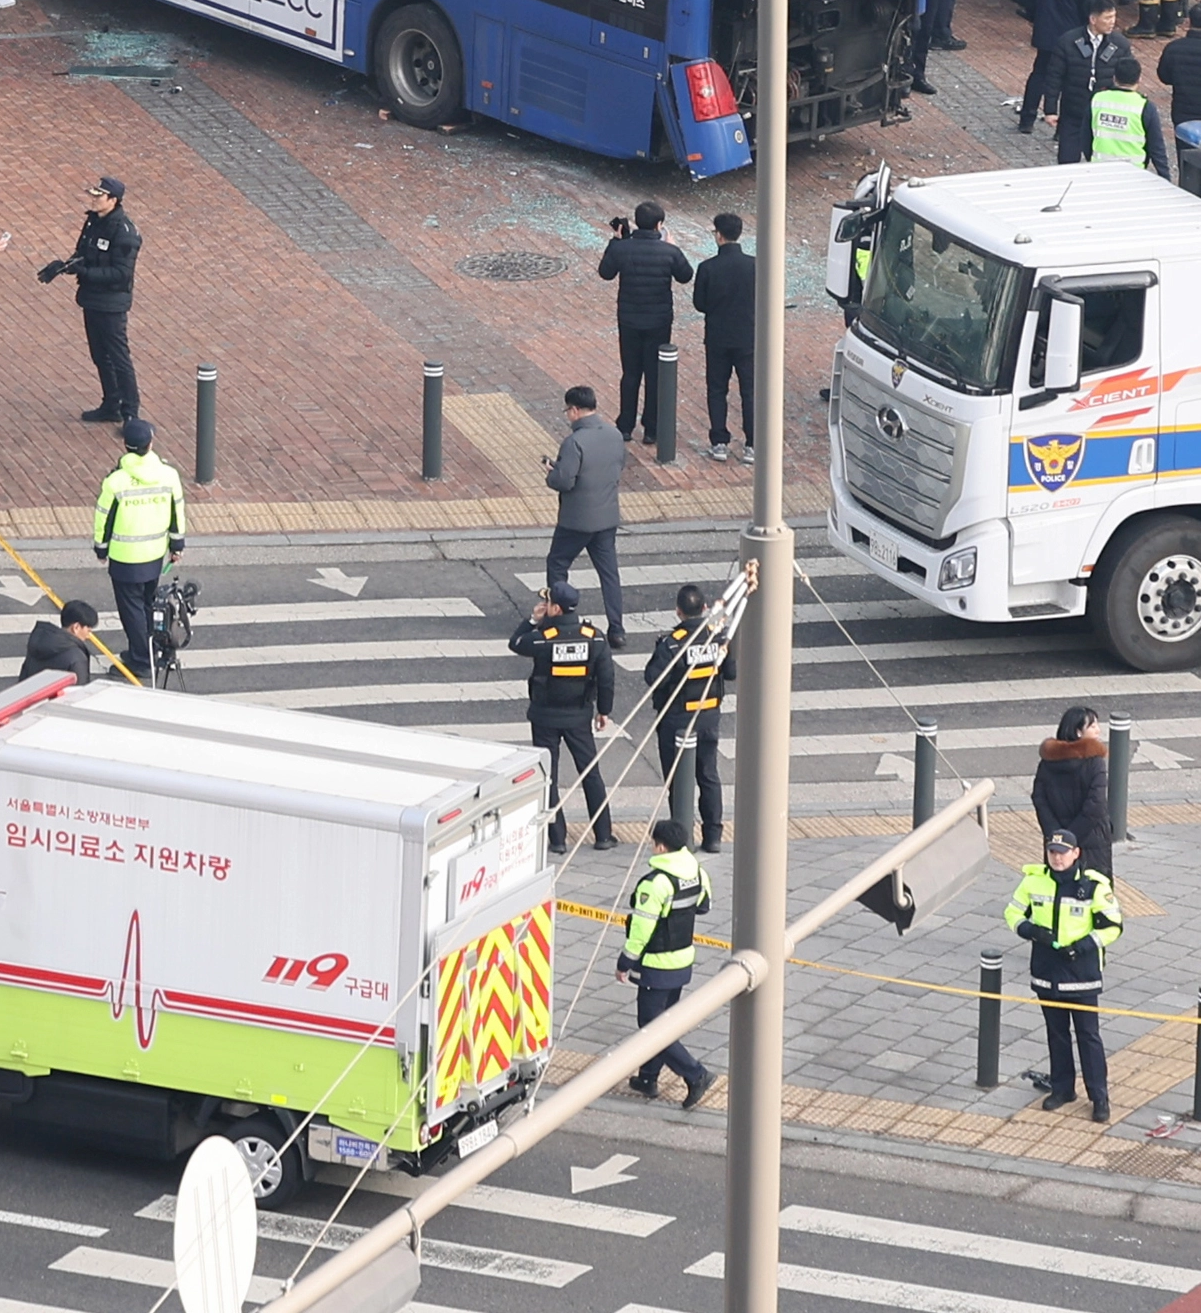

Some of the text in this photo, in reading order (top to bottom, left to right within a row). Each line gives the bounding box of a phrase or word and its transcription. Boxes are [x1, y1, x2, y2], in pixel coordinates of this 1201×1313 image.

[1041, 474, 1066, 483] POLICE
[124, 496, 167, 507] POLICE
[7, 797, 150, 831] 서울특별시 소방재난본부
[6, 822, 232, 881] 임시의료소 지원차량
[460, 866, 486, 904] 119
[261, 953, 389, 1002] 119 구급대
